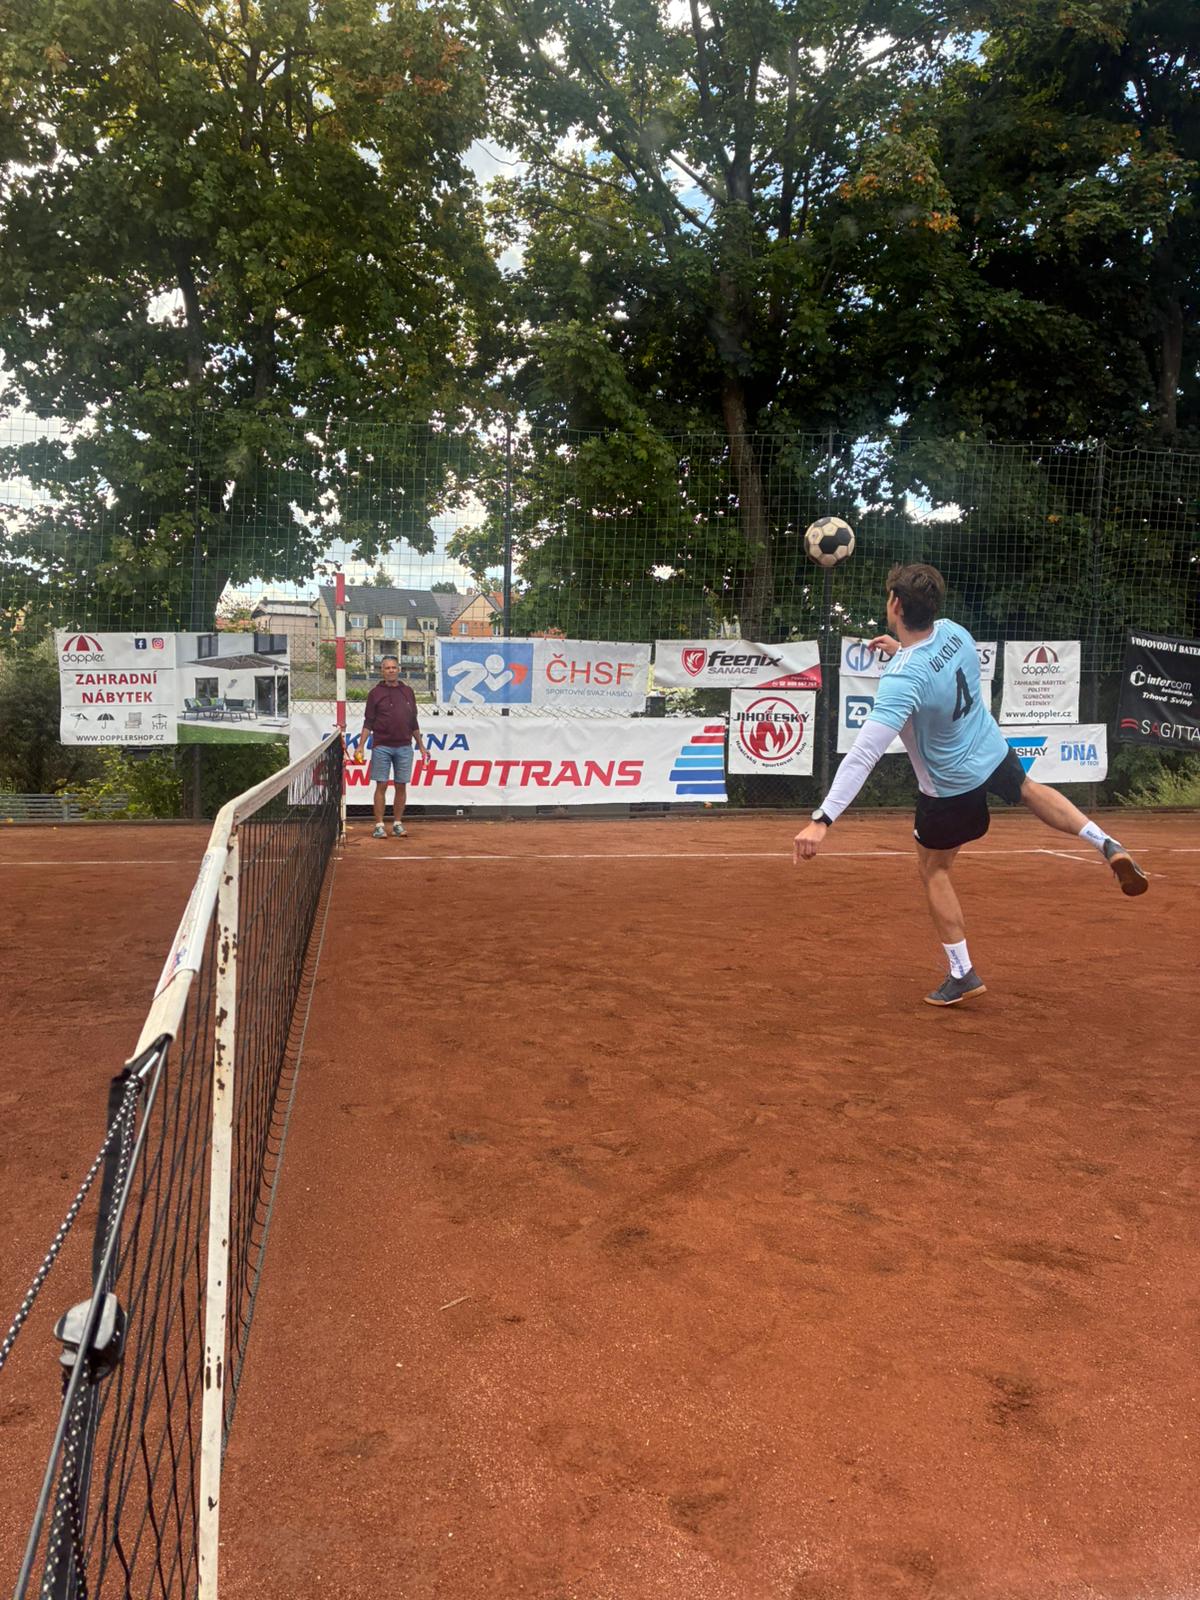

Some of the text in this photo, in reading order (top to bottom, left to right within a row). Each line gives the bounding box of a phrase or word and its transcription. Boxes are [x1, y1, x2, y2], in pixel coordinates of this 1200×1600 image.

[938, 633, 964, 663] KOLÍN
[1131, 636, 1178, 653] VODOVODNÍ
[62, 652, 105, 664] doppler
[708, 650, 782, 668] feenix
[545, 653, 635, 685] ČHSF
[707, 666, 758, 675] SANACE
[1021, 663, 1061, 676] doppler
[75, 671, 157, 685] ZAHRADNÍ
[1147, 673, 1192, 690] intercom
[82, 689, 153, 704] NÁBYTEK
[545, 688, 586, 696] SPORTOVNÍ
[587, 689, 605, 697] SVAZ
[952, 666, 974, 722] 4
[1142, 691, 1193, 707] Trhové Sviny
[733, 711, 810, 723] JIHOČESKÝ
[1005, 710, 1072, 719] www.doppler.cz
[75, 734, 165, 742] WWW.DOPPLERSHOP.CZ
[1060, 744, 1098, 761] DNA
